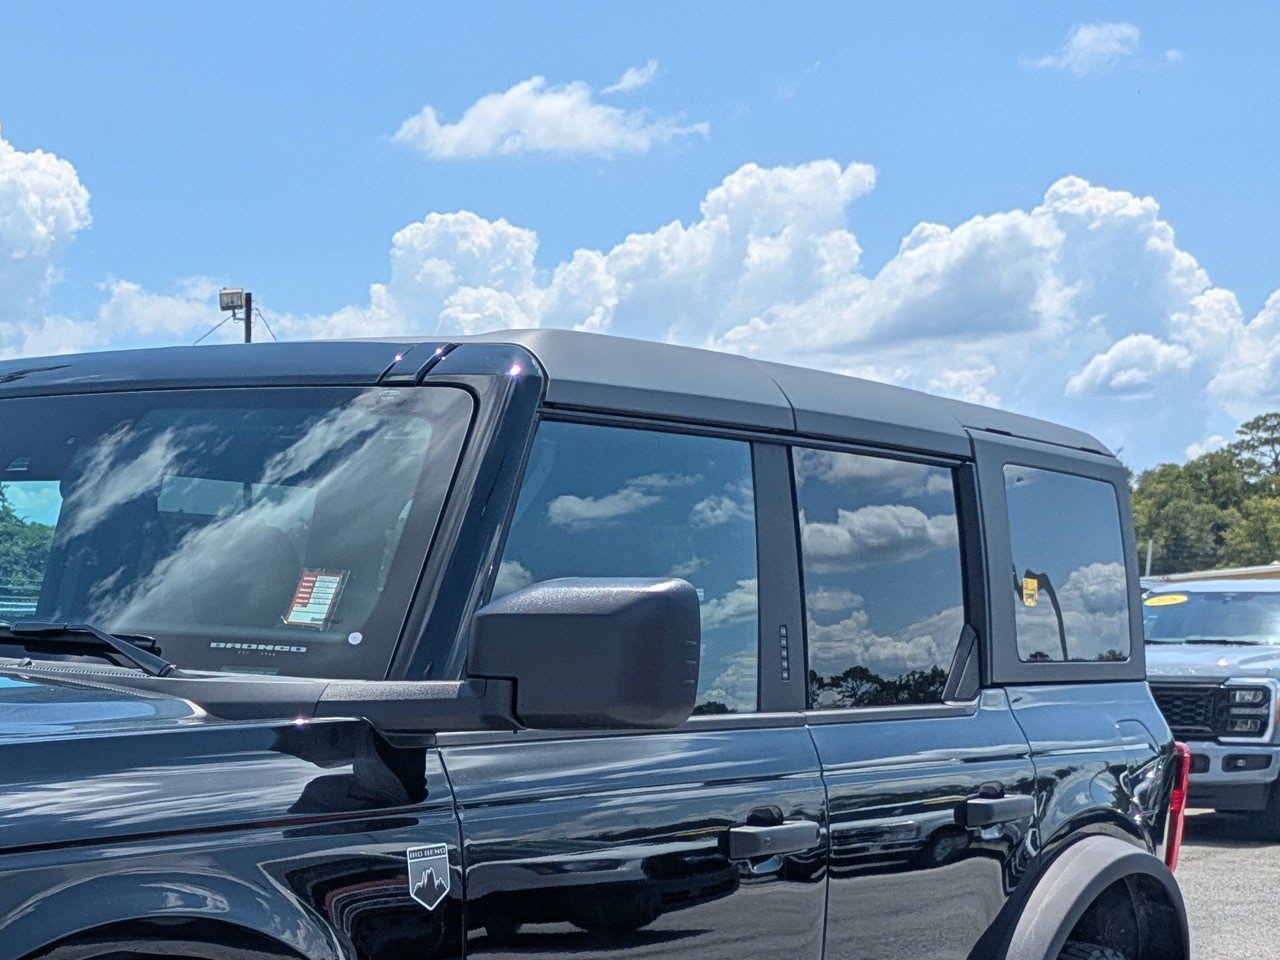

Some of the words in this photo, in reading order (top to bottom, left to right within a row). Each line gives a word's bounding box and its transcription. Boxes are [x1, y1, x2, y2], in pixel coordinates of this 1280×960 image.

[210, 642, 307, 652] BRONCO
[410, 850, 423, 858] BIG
[424, 848, 446, 856] BEND
